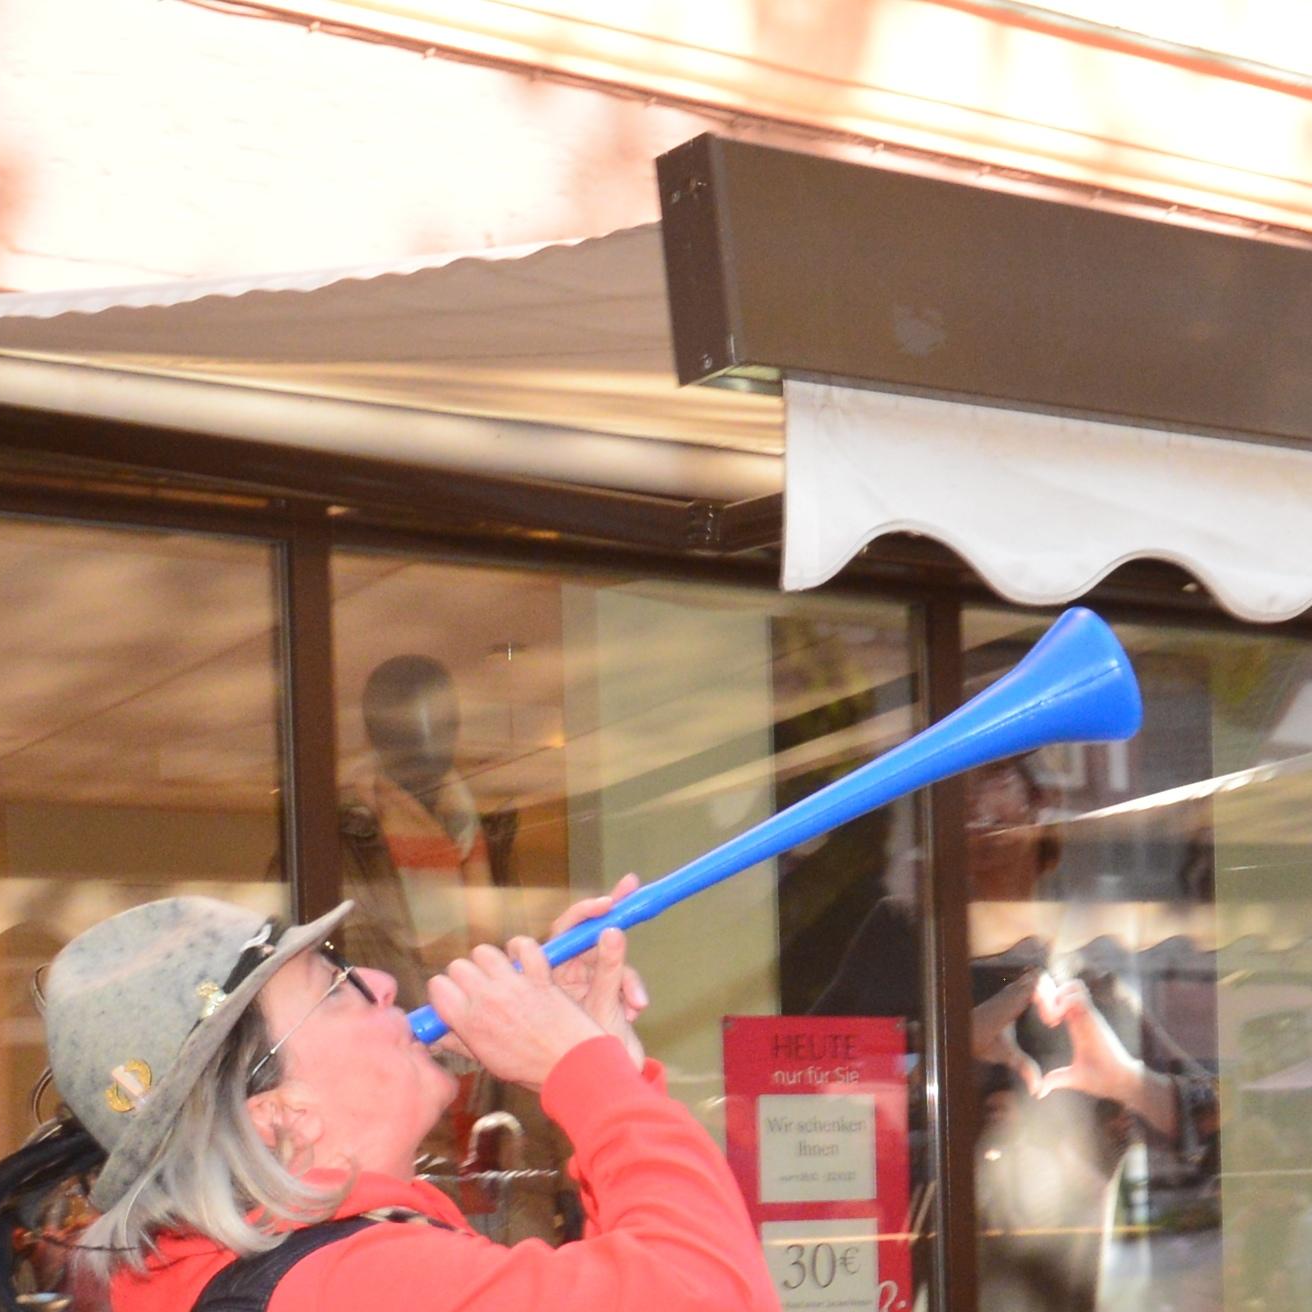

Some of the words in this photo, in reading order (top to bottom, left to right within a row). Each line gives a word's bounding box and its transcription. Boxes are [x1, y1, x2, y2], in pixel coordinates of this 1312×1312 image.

[773, 1033, 859, 1060] HEUTE
[773, 1069, 802, 1084] nur
[806, 1065, 829, 1084] für
[834, 1066, 860, 1084] Sie
[767, 1116, 793, 1133] Wir
